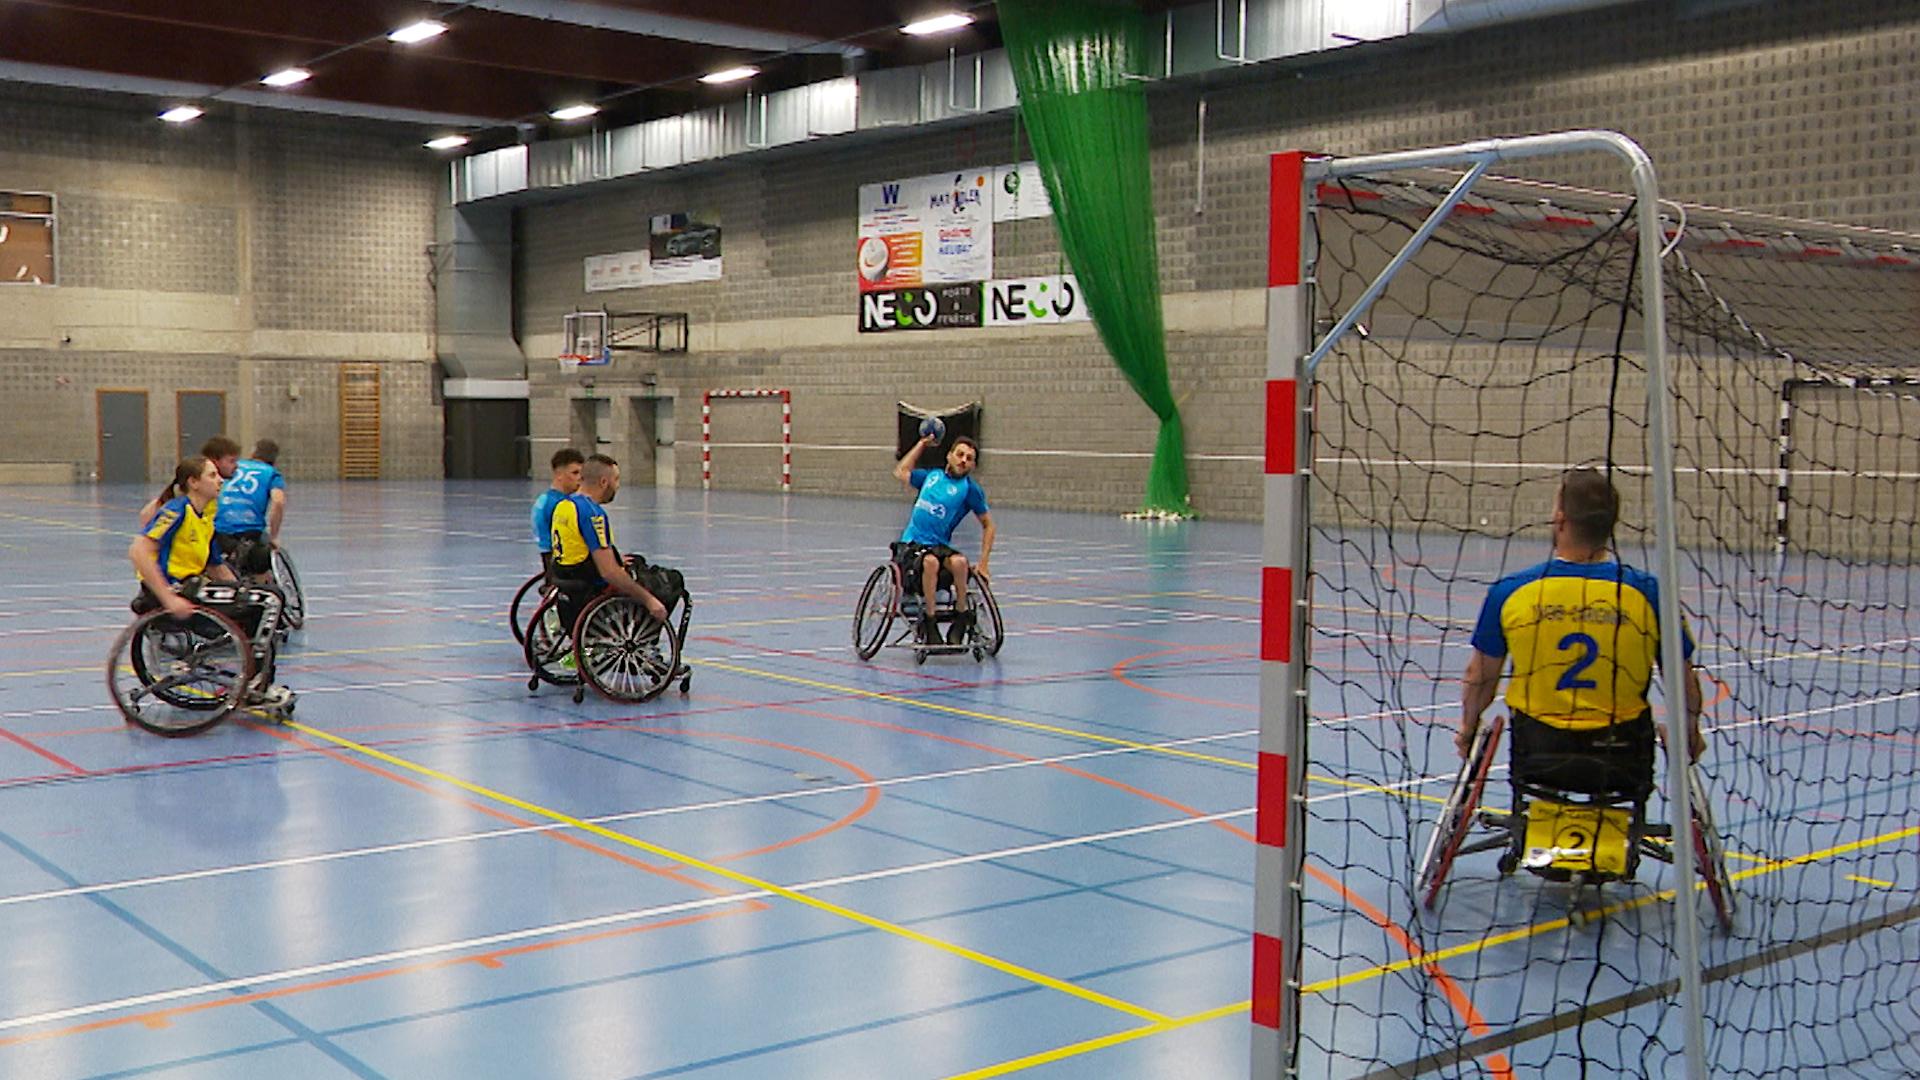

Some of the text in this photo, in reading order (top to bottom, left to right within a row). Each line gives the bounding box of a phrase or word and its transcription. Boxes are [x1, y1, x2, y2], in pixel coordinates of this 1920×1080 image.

[882, 184, 900, 205] W
[224, 470, 261, 495] 25
[1555, 632, 1599, 691] 2
